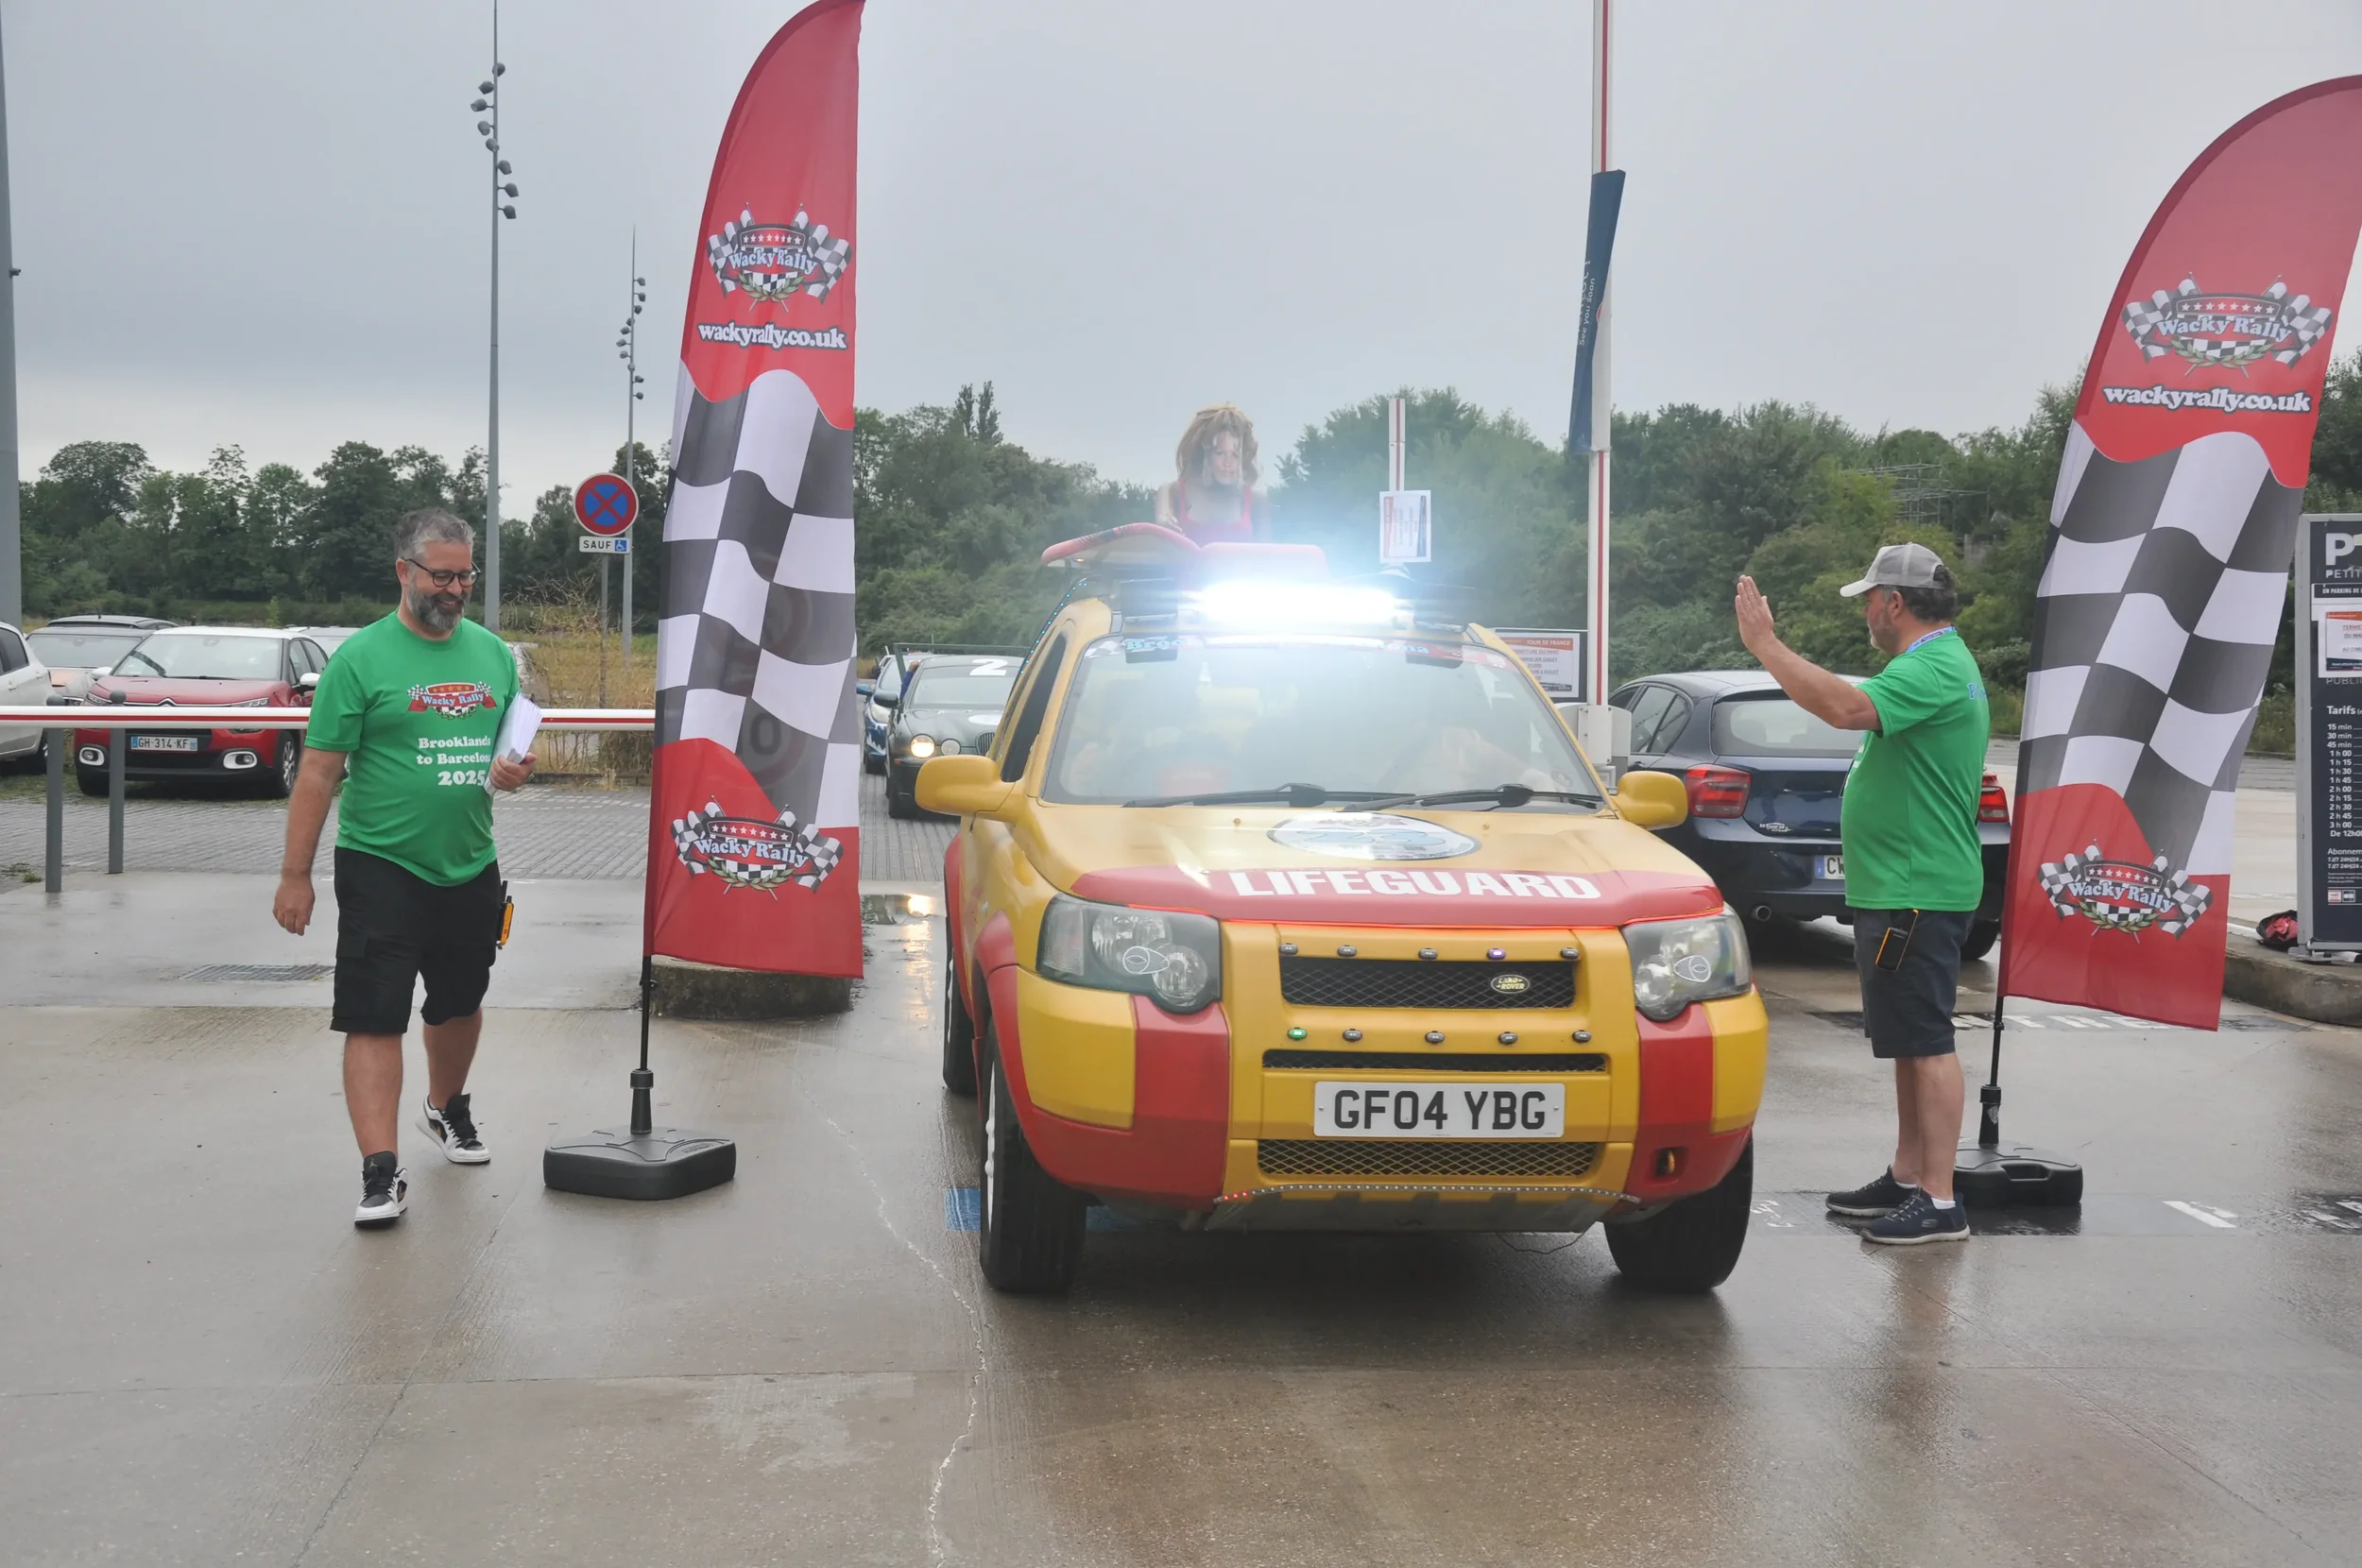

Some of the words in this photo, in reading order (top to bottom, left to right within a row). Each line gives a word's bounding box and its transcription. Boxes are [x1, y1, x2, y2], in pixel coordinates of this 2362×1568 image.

[728, 249, 775, 270] Wacky
[777, 249, 818, 275] Rally
[697, 321, 847, 349] wackyrally.co.uk
[2157, 315, 2230, 336] Wacky
[2233, 316, 2292, 342] Rally
[2102, 384, 2311, 413] wackyrally.co.uk
[583, 540, 611, 550] SAUF
[969, 658, 1008, 675] 2
[421, 695, 455, 706] Wacky
[458, 692, 485, 704] Rally
[2326, 706, 2356, 715] Tarifs
[138, 738, 189, 749] GH-314-KF
[419, 736, 490, 749] Brooklands
[416, 755, 433, 765] to
[437, 770, 486, 786] 2025
[693, 839, 753, 858] Wacky
[756, 842, 809, 868] Rally
[1228, 870, 1602, 900] LIFEGUARD
[2067, 880, 2127, 901] Wacky
[2127, 884, 2176, 913] Rally
[1334, 1089, 1448, 1130] GF04
[1463, 1090, 1546, 1131] YBG
